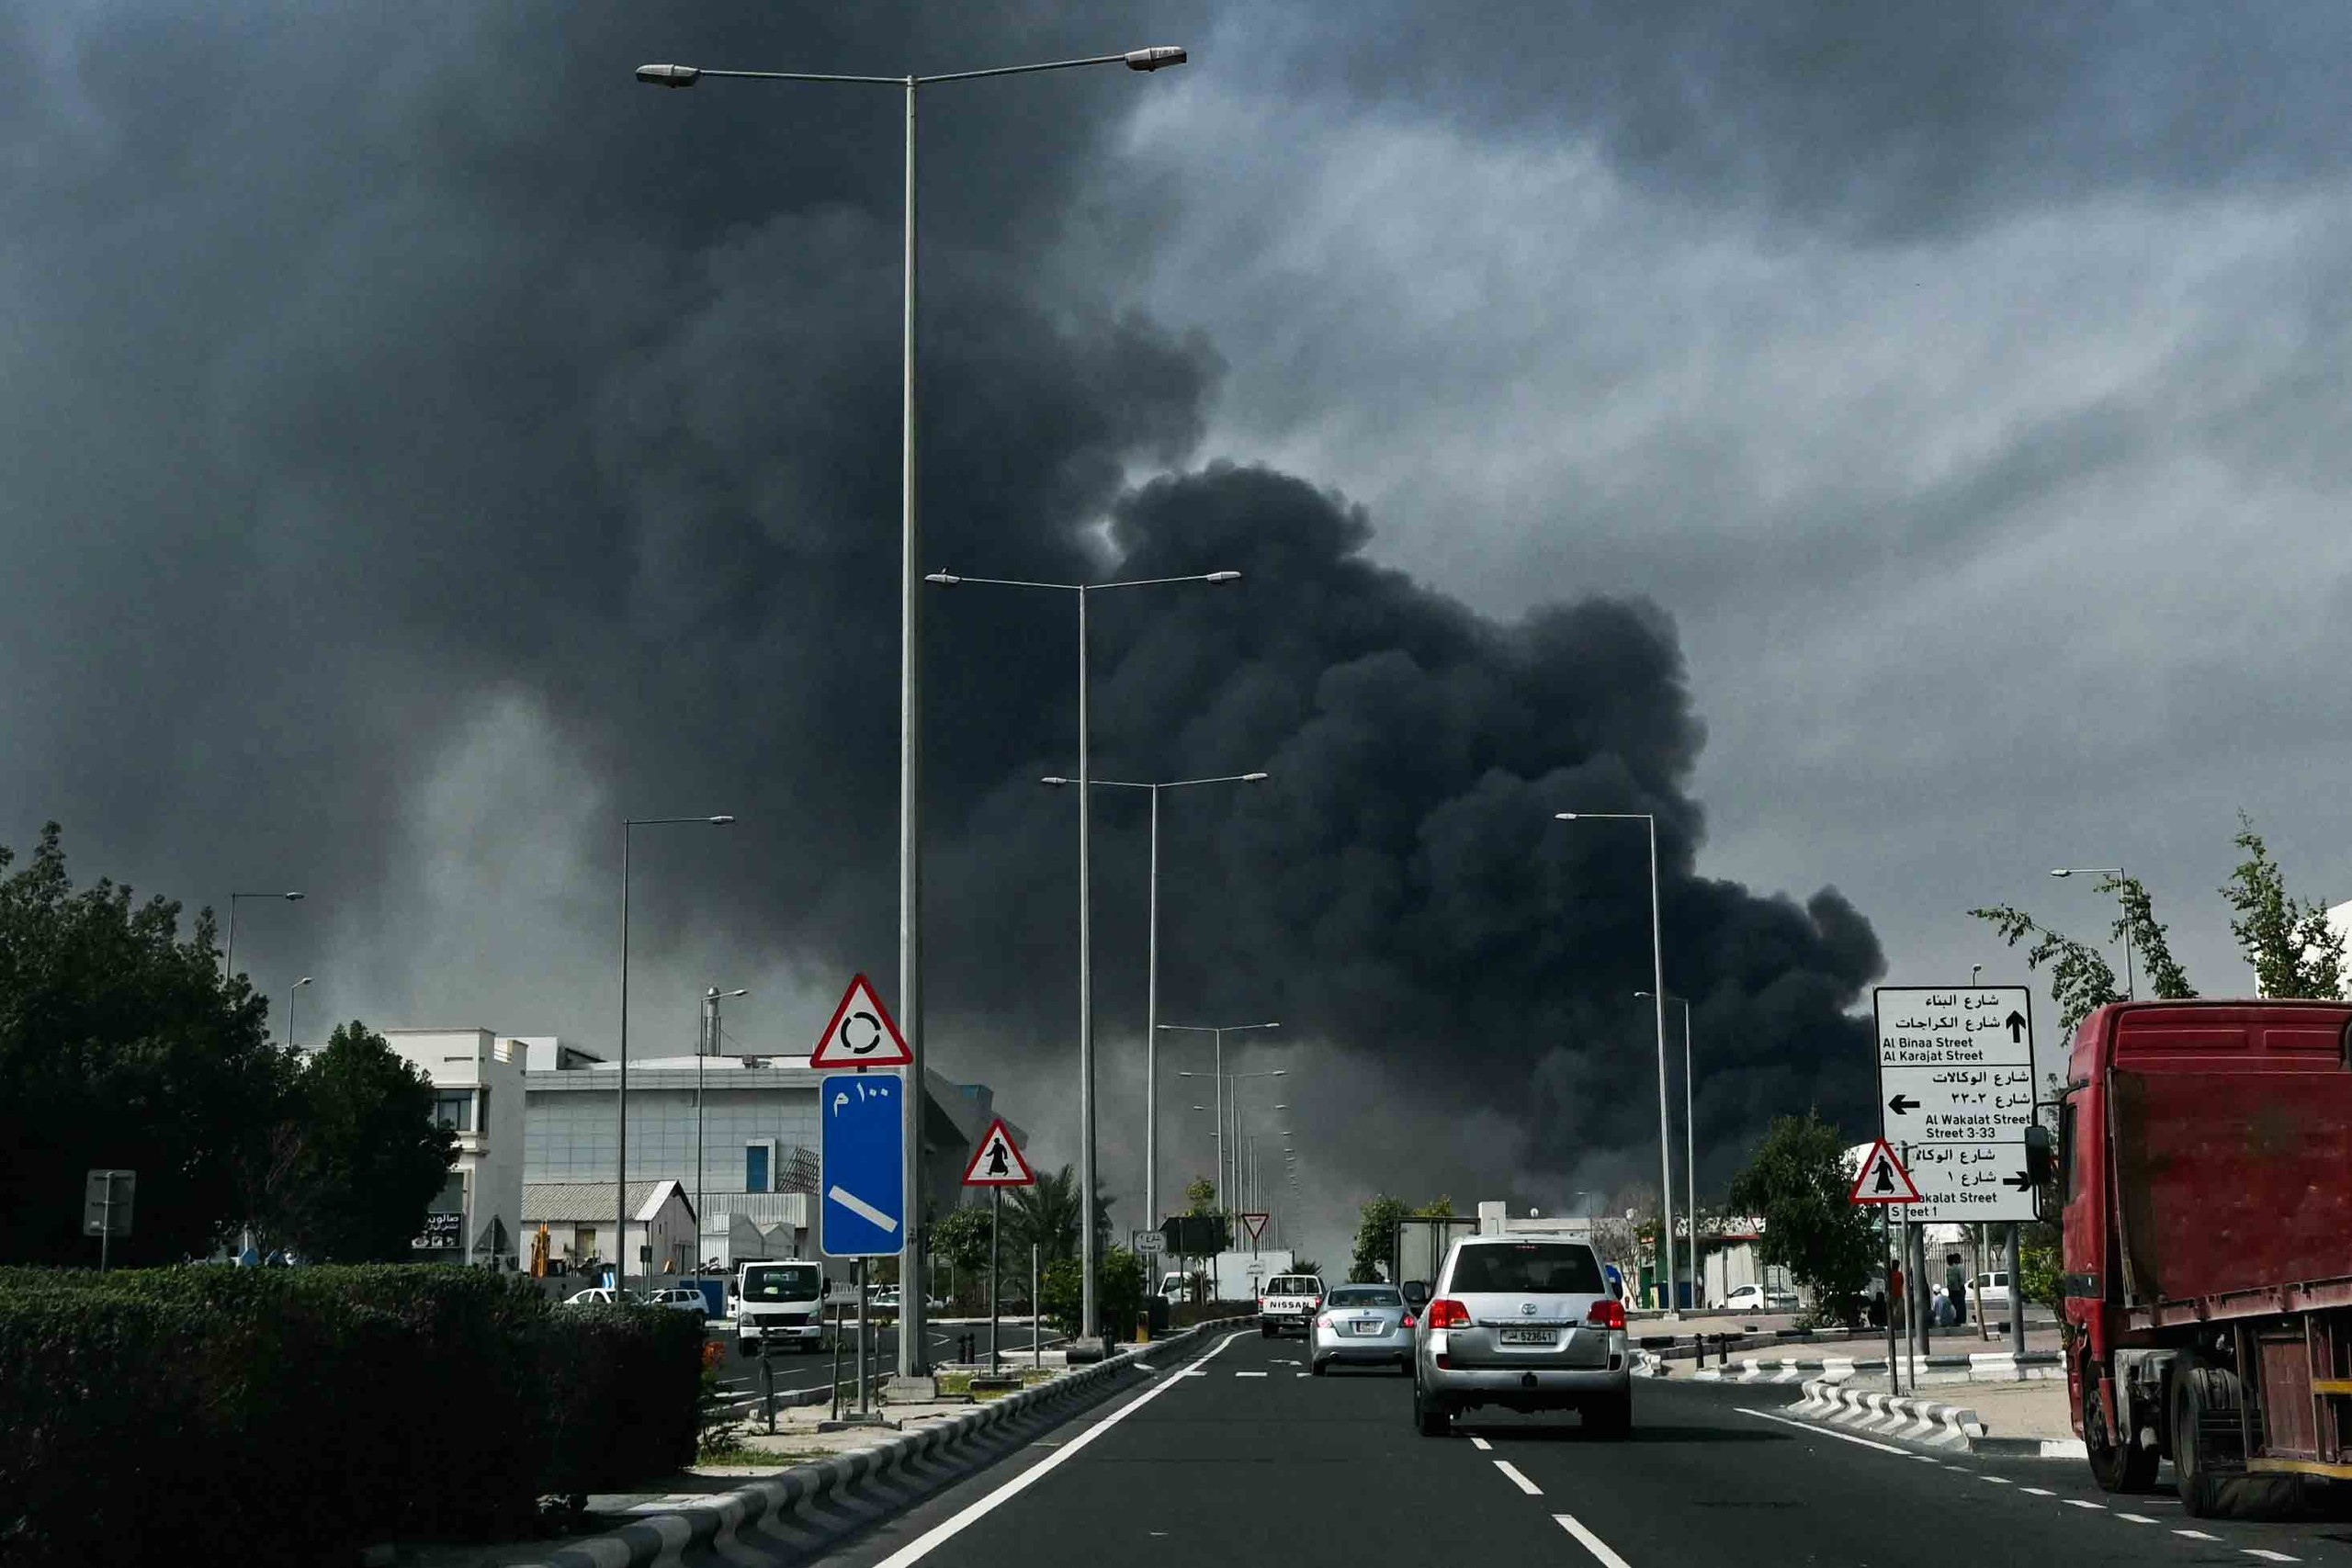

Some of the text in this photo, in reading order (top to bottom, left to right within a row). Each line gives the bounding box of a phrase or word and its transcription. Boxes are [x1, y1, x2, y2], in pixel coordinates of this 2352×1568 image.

[1926, 994, 1999, 1010] شارع البناء
[1895, 1016, 2000, 1032] شارع الكراجات
[1883, 1037, 1973, 1048] Al Binaa Street
[1883, 1050, 1984, 1063] Al Karajat Street
[1932, 1071, 2030, 1086] شارع الوكالات
[833, 1092, 849, 1118] م
[1995, 1093, 2030, 1109] شارع
[1926, 1113, 2031, 1125] Al Wakalat Street
[1926, 1127, 1996, 1139] Street 3-33
[1916, 1149, 1996, 1164] شارع الوكالا
[1948, 1171, 1996, 1187] شارع ١
[1919, 1191, 1997, 1203] akalat Street
[1892, 1206, 1937, 1217] Sreet 1
